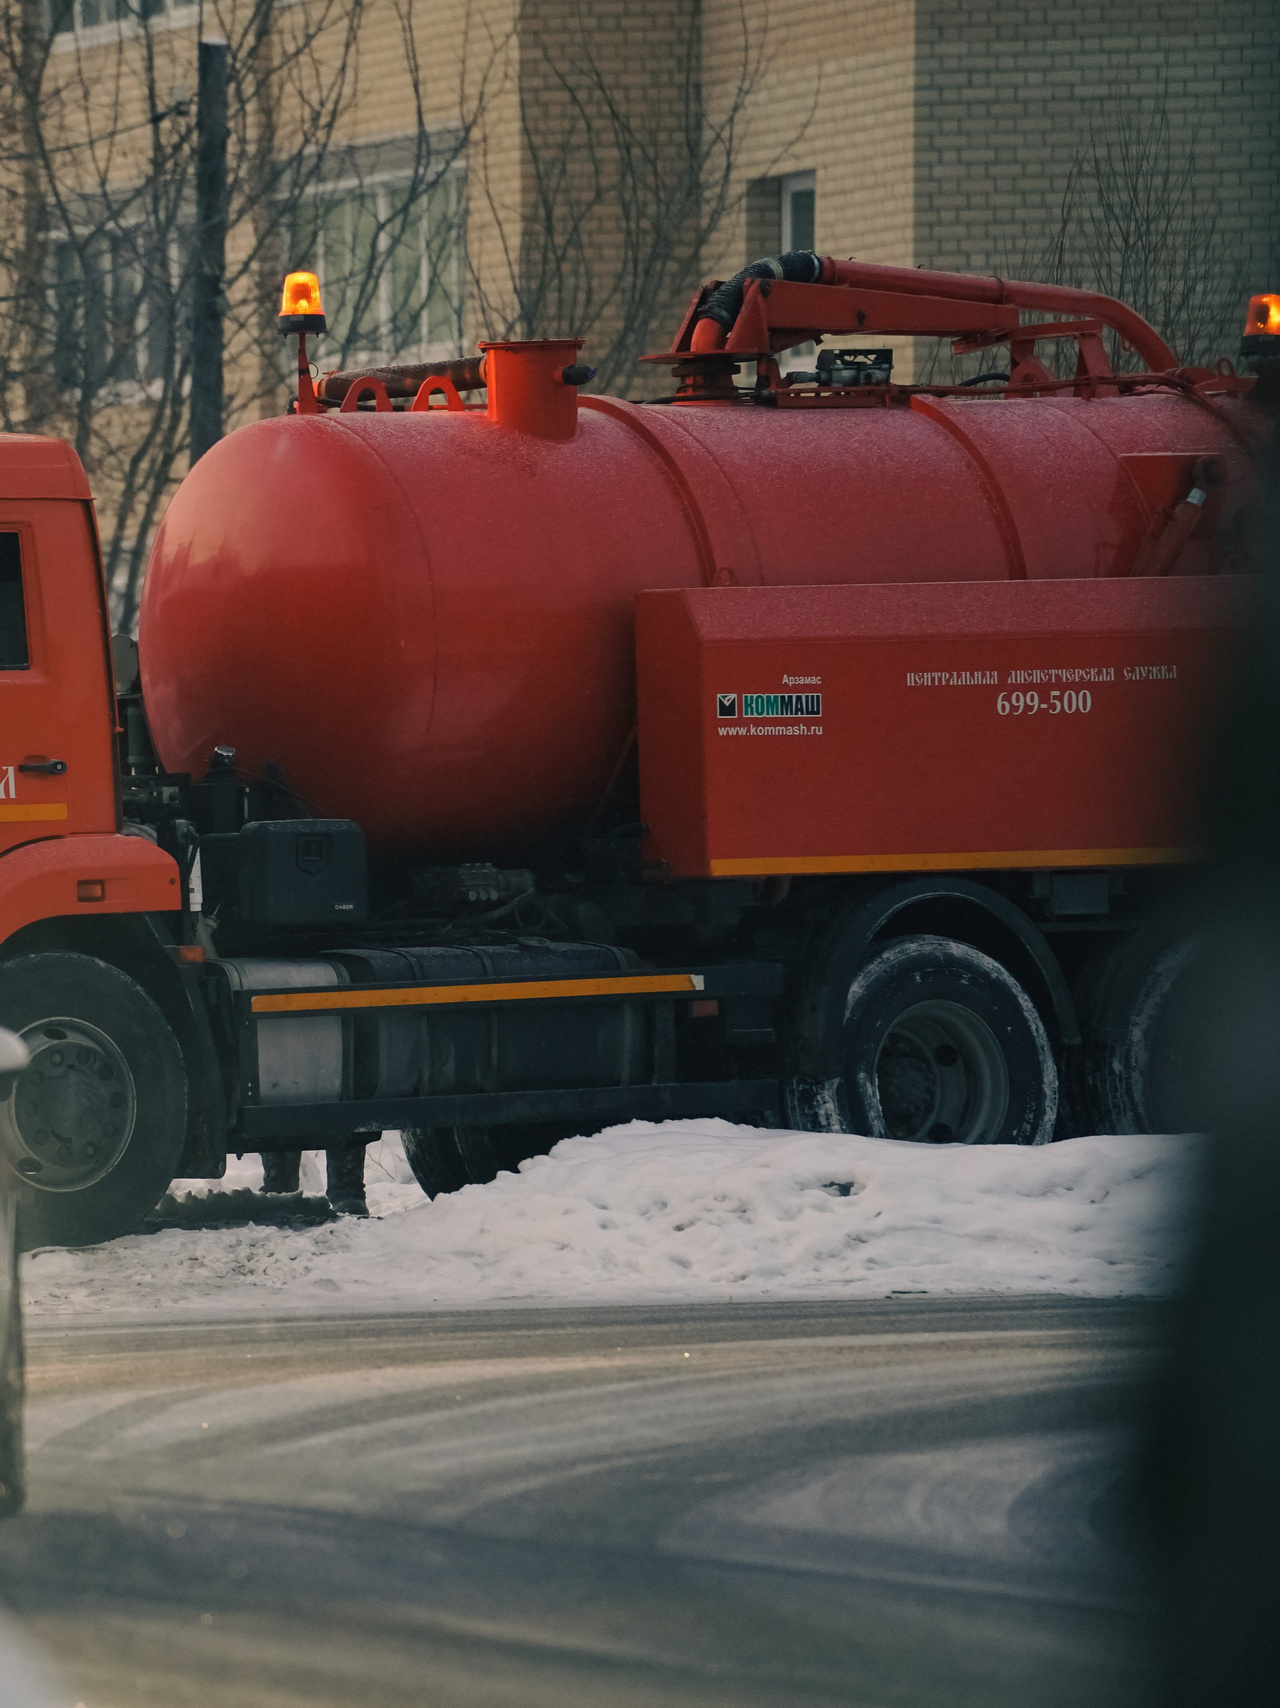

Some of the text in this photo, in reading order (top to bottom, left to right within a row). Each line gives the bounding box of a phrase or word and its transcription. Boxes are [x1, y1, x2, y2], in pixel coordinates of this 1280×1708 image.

[782, 674, 822, 686] Арзамас
[906, 665, 1177, 687] ЦЕНТРАЛЬНАЯ ДИСПЕТЧЕРСКАЯ СЛУЖБА
[743, 693, 822, 717] КОММАШ
[996, 689, 1092, 716] 699-500
[718, 724, 823, 736] www.kommash.ru
